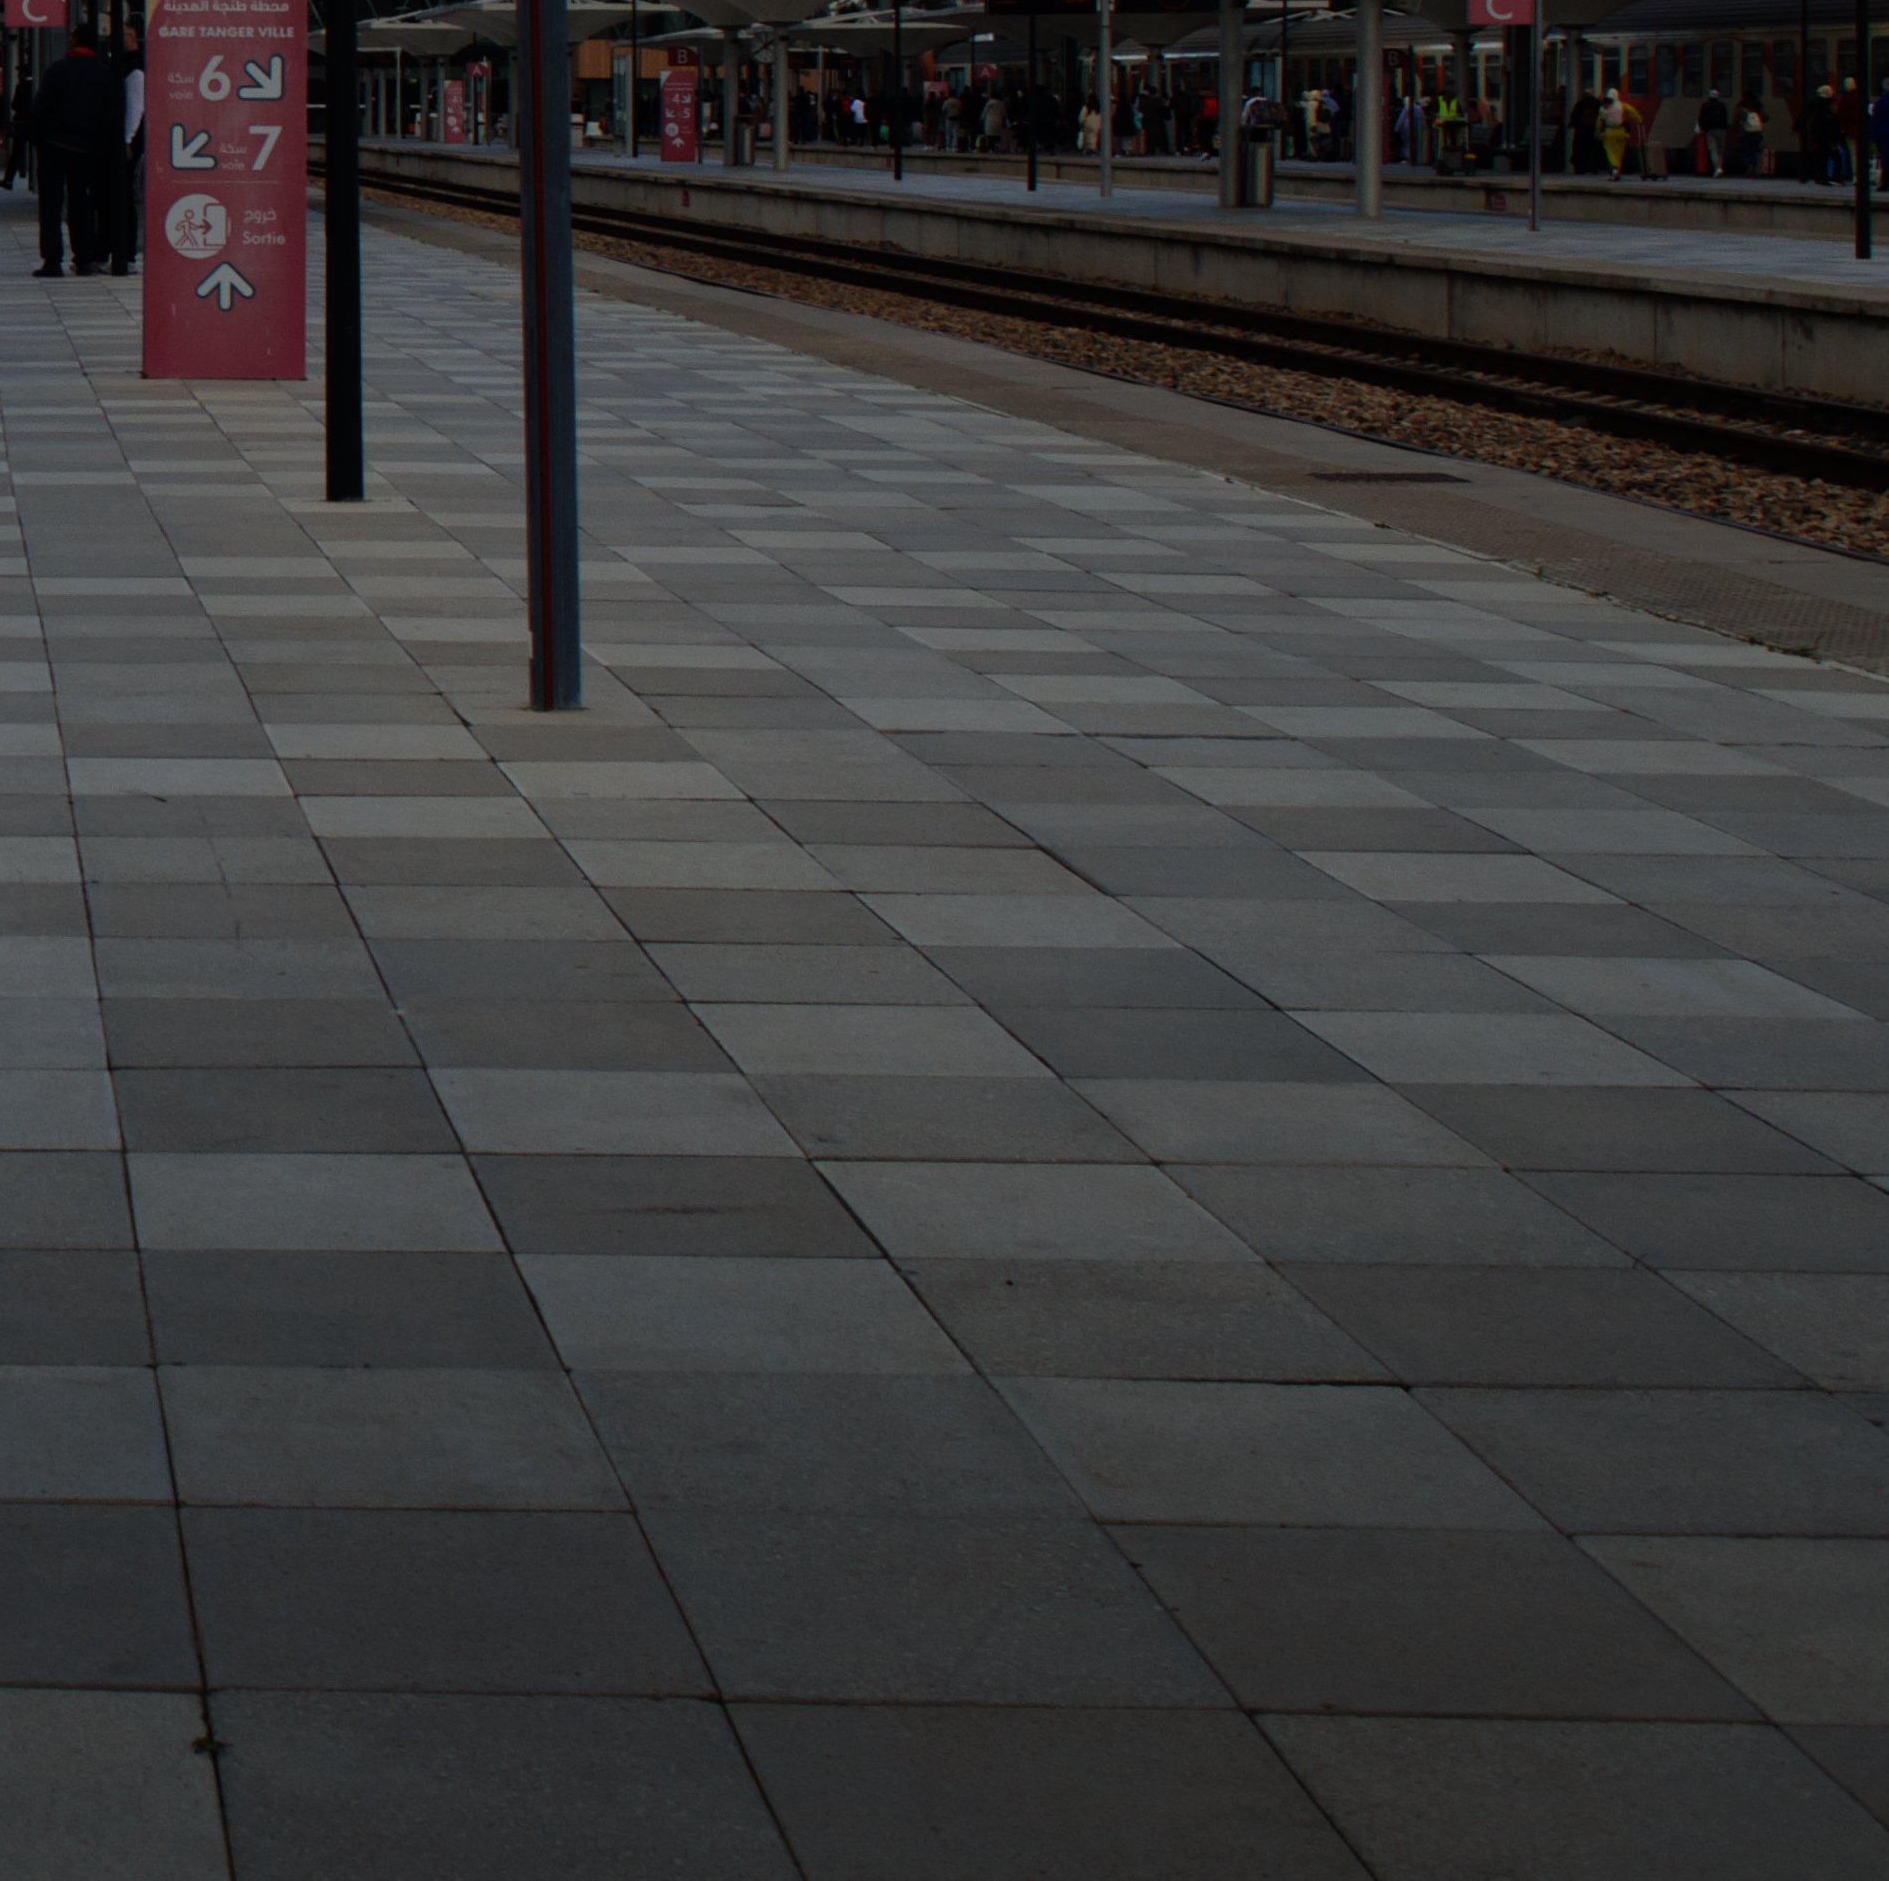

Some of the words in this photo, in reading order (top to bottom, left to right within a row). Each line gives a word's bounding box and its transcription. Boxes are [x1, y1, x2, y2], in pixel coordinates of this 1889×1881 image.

[163, 0, 209, 15] المدينة
[212, 0, 247, 15] طنجة
[251, 0, 289, 13] محطة
[158, 25, 195, 38] GARE
[198, 25, 255, 38] TANGER
[257, 25, 295, 38] VILLE
[677, 49, 688, 64] B
[1387, 50, 1399, 66] B
[167, 72, 194, 84] سكة
[198, 54, 231, 101] 6
[169, 90, 193, 100] voie
[219, 142, 248, 154] سكة
[248, 125, 282, 171] 7
[220, 158, 245, 171] voie
[243, 206, 277, 224] خروج
[242, 230, 287, 246] Sortie
